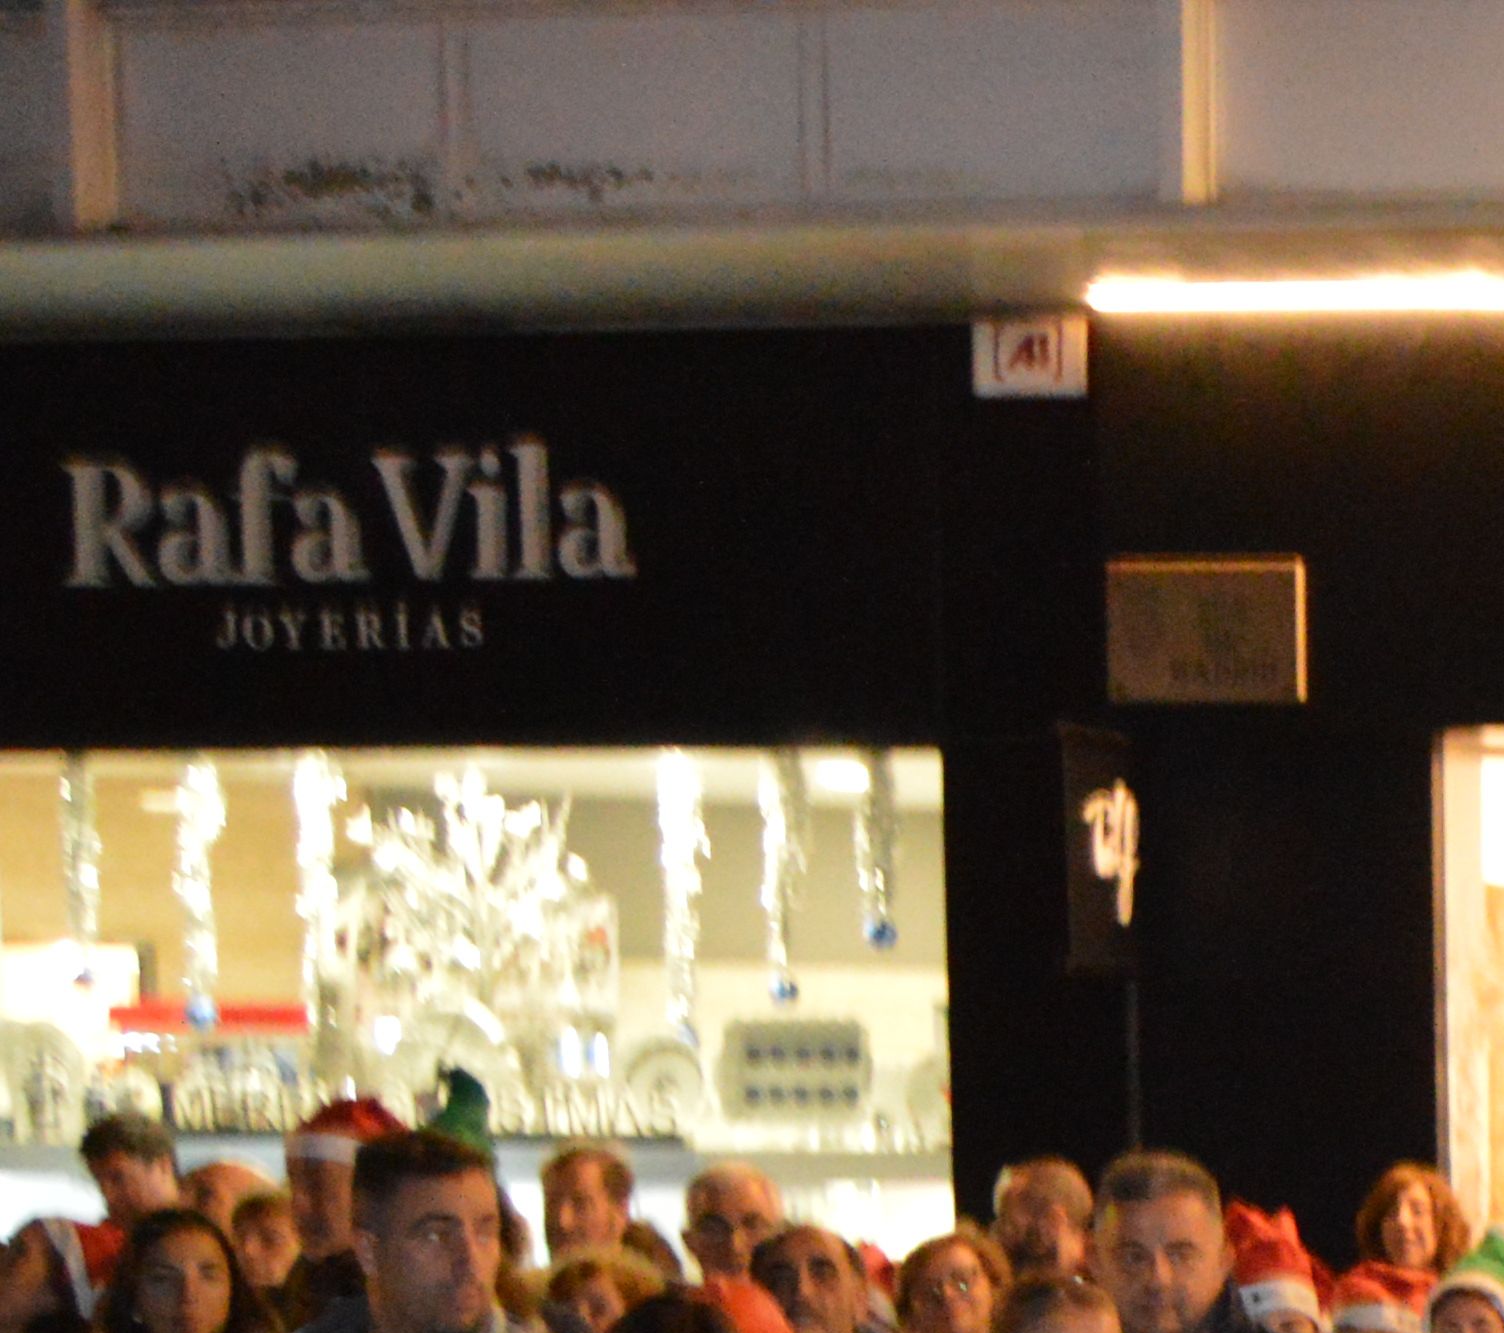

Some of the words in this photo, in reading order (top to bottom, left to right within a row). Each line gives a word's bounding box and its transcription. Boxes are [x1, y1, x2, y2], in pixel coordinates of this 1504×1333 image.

[61, 442, 370, 590] Rafa
[372, 431, 638, 582] Vila
[216, 599, 487, 652] JOYERÍAS
